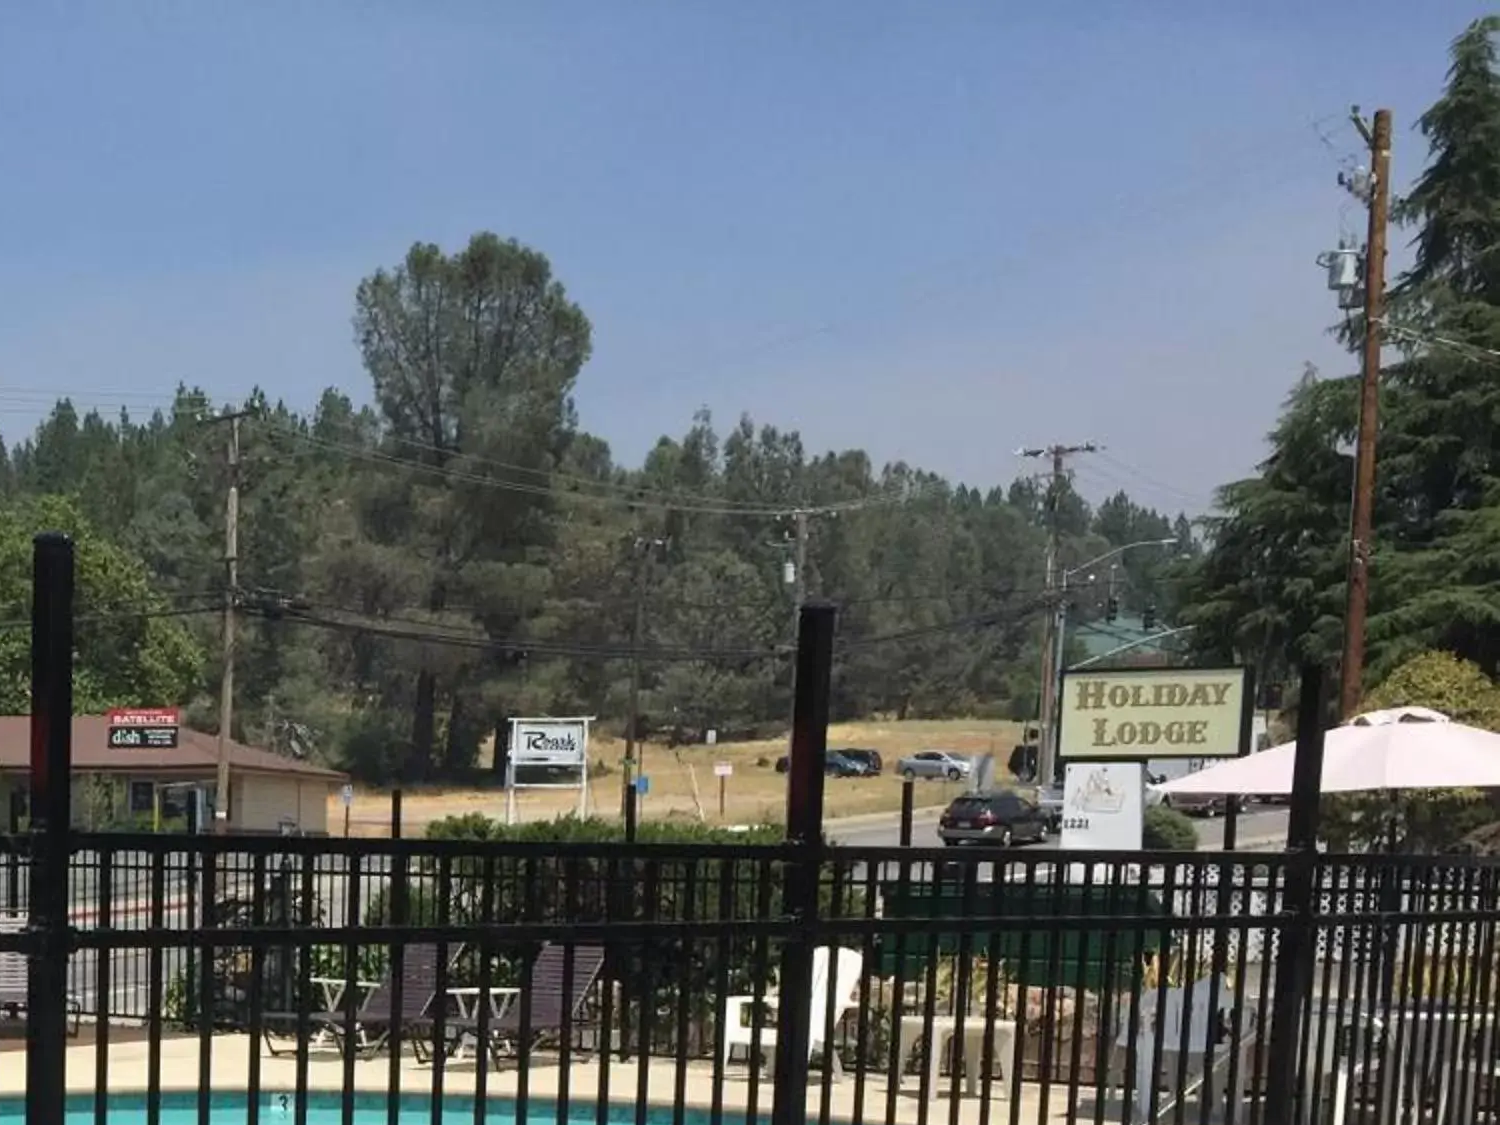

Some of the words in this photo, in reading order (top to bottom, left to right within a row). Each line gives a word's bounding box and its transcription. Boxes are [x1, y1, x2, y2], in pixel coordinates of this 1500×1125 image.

[1075, 681, 1232, 711] HOLIDAY
[111, 729, 141, 745] dish
[1092, 718, 1208, 747] LODGE
